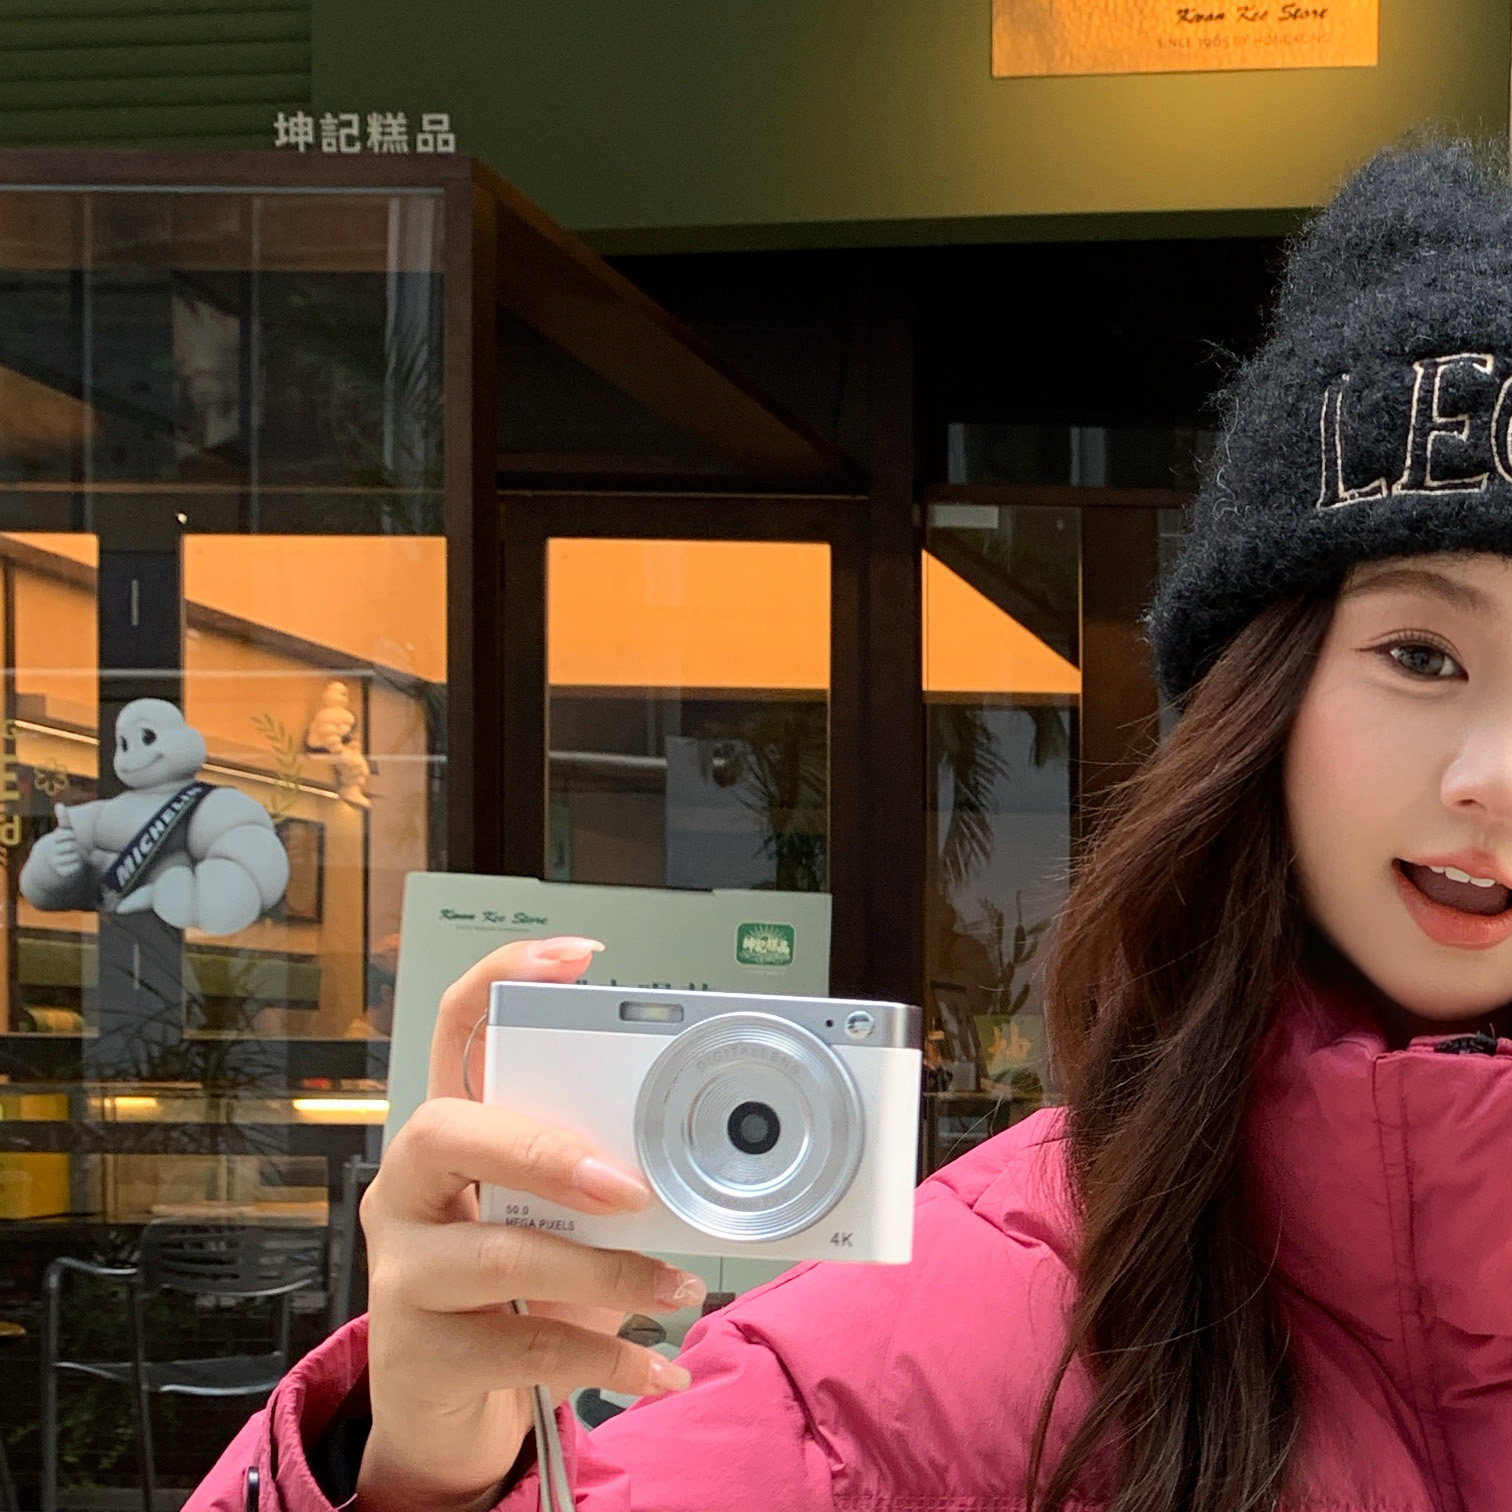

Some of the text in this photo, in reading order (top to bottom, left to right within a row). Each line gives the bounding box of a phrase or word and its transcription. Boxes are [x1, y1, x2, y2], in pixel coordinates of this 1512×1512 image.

[1278, 3, 1328, 22] Store
[273, 110, 456, 153] 坤記糕品
[115, 786, 204, 888] MICHELIN
[829, 1231, 854, 1247] 4K
